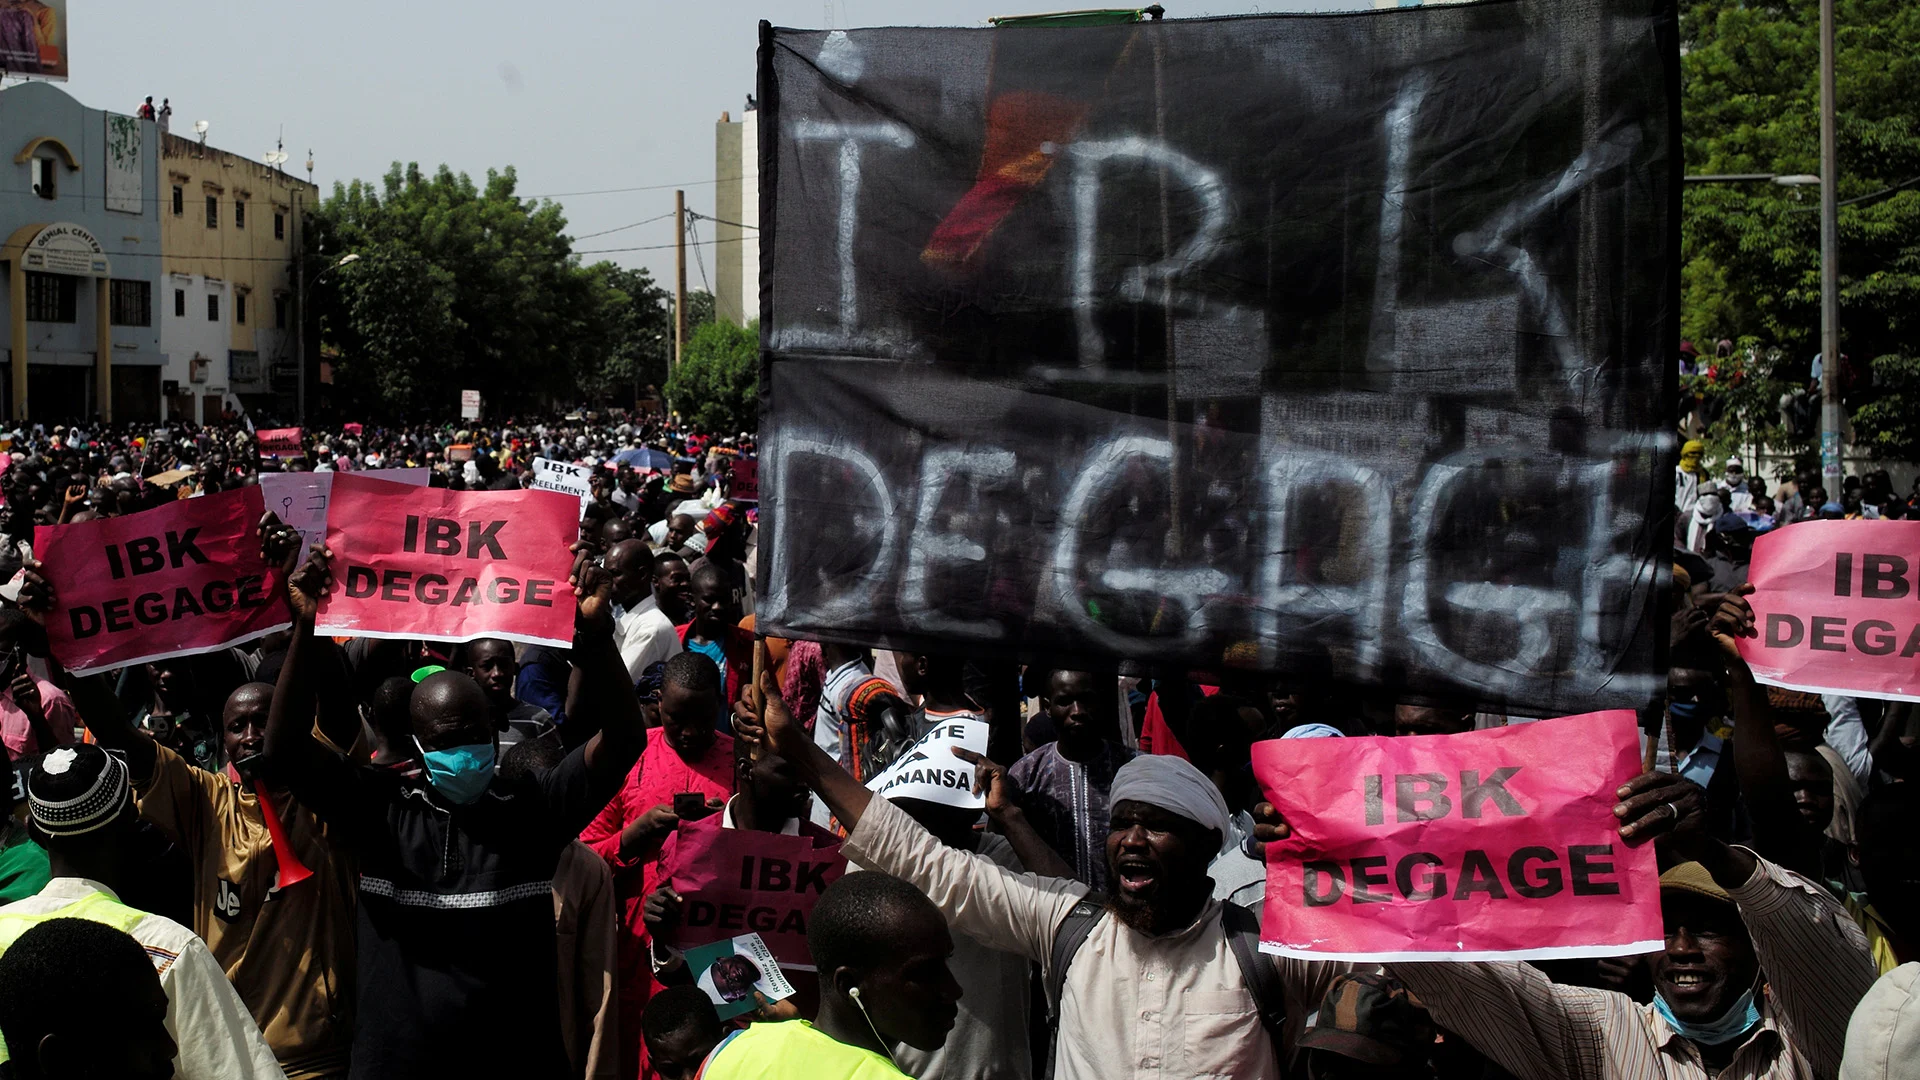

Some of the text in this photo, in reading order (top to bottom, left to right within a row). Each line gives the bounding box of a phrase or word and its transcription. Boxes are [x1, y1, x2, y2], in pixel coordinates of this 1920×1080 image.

[71, 228, 101, 254] CENTER
[270, 434, 290, 443] IBK
[543, 461, 580, 477] IBK
[555, 474, 563, 485] SI
[105, 526, 209, 580] IBK
[402, 514, 508, 560] IBK
[345, 565, 555, 608] DEGAGE
[1834, 552, 1920, 601] IB
[68, 575, 267, 640] DEGAGE
[1364, 766, 1526, 827] IBK
[739, 856, 834, 895] IBK
[1302, 844, 1622, 907] DEGAGE
[217, 880, 240, 917] Je
[688, 900, 807, 936] DEGA
[753, 935, 770, 958] CISSE
[750, 943, 780, 993] Rendez nous
